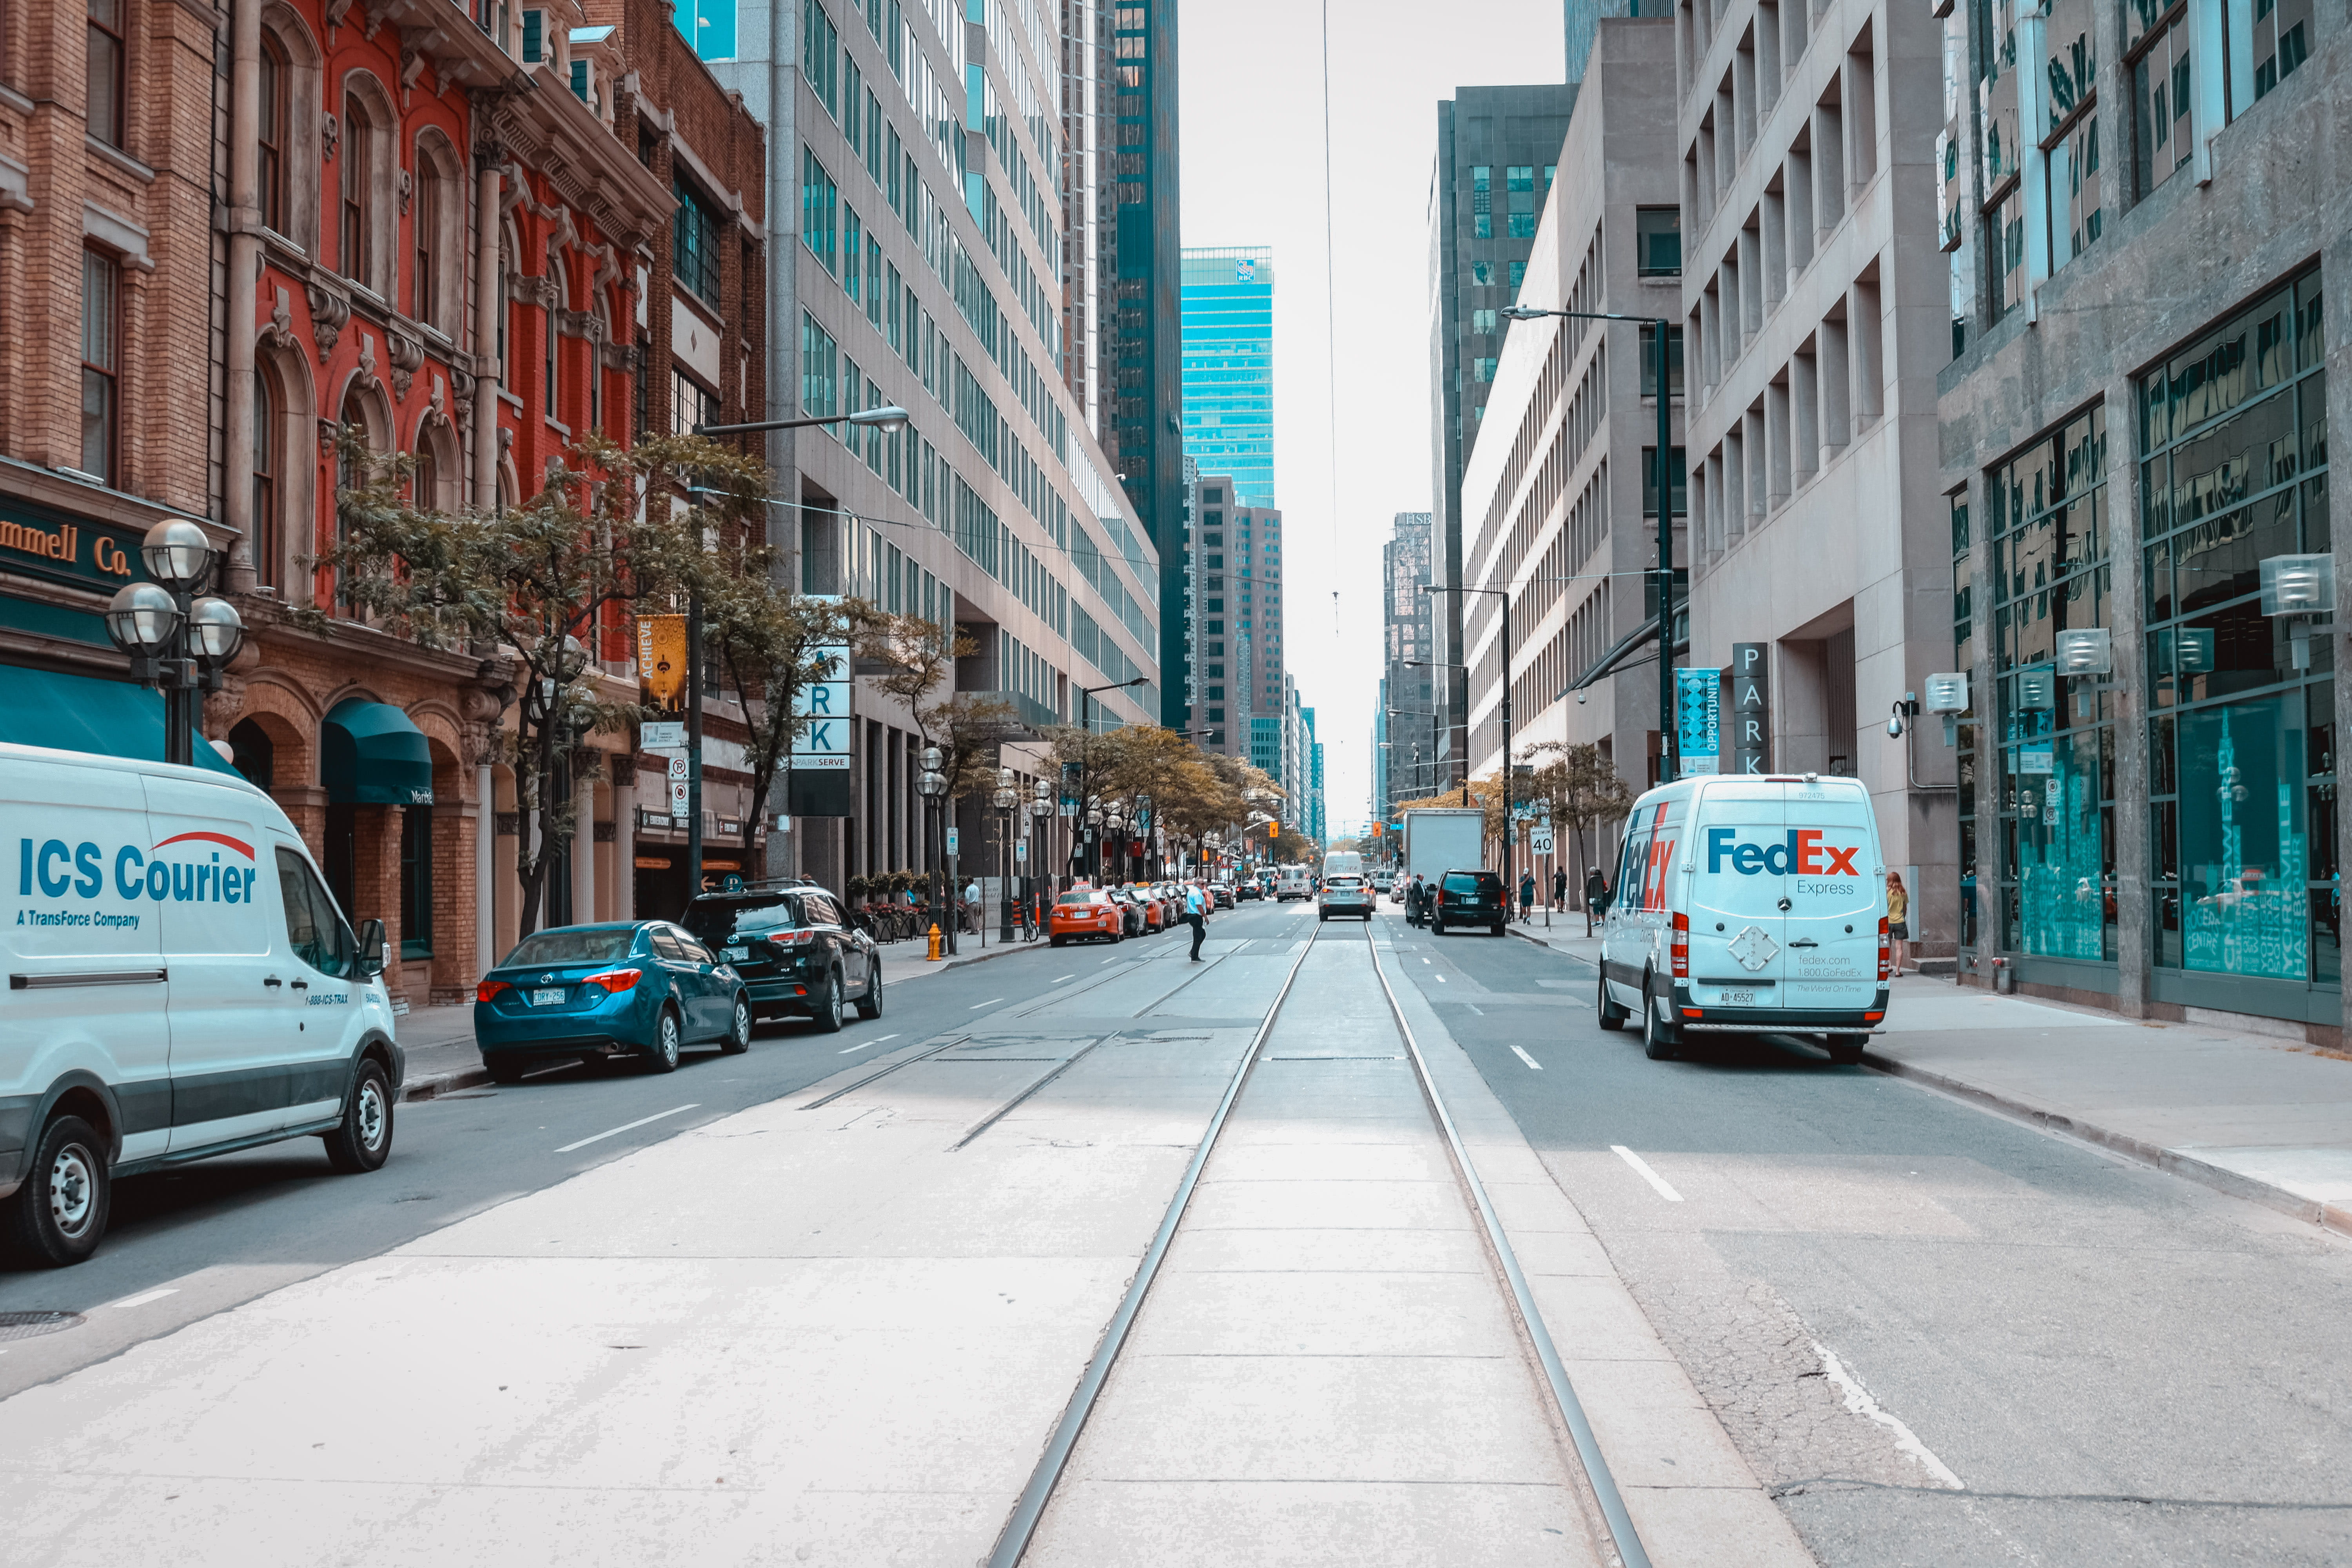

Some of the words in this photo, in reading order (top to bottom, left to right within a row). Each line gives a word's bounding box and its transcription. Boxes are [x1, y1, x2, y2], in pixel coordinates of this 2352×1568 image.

[94, 536, 131, 577] Co.
[640, 621, 653, 679] ACHIEVE
[1708, 673, 1718, 751] OPPORTUNITY
[1743, 649, 1762, 774] PARK
[1533, 838, 1552, 851] 40
[1708, 828, 1860, 877] FedEx
[20, 838, 103, 899] ICS
[115, 845, 256, 904] Courier
[1797, 880, 1854, 897] Express
[2279, 788, 2293, 973] YORKVILLE
[17, 909, 25, 926] A
[29, 910, 90, 926] TransForce
[94, 911, 140, 930] Company
[2039, 868, 2047, 954] IGH
[2184, 907, 2221, 938] ROGERS
[2292, 838, 2303, 976] HARBOUR
[1798, 955, 1850, 965] fedex.com
[2187, 931, 2218, 956] CENTRE
[2223, 922, 2234, 971] CN
[1798, 968, 1862, 977] 1.800.GoFedEx
[305, 993, 348, 1006] 1-888-ICS-TRAX
[553, 991, 564, 1000] 256
